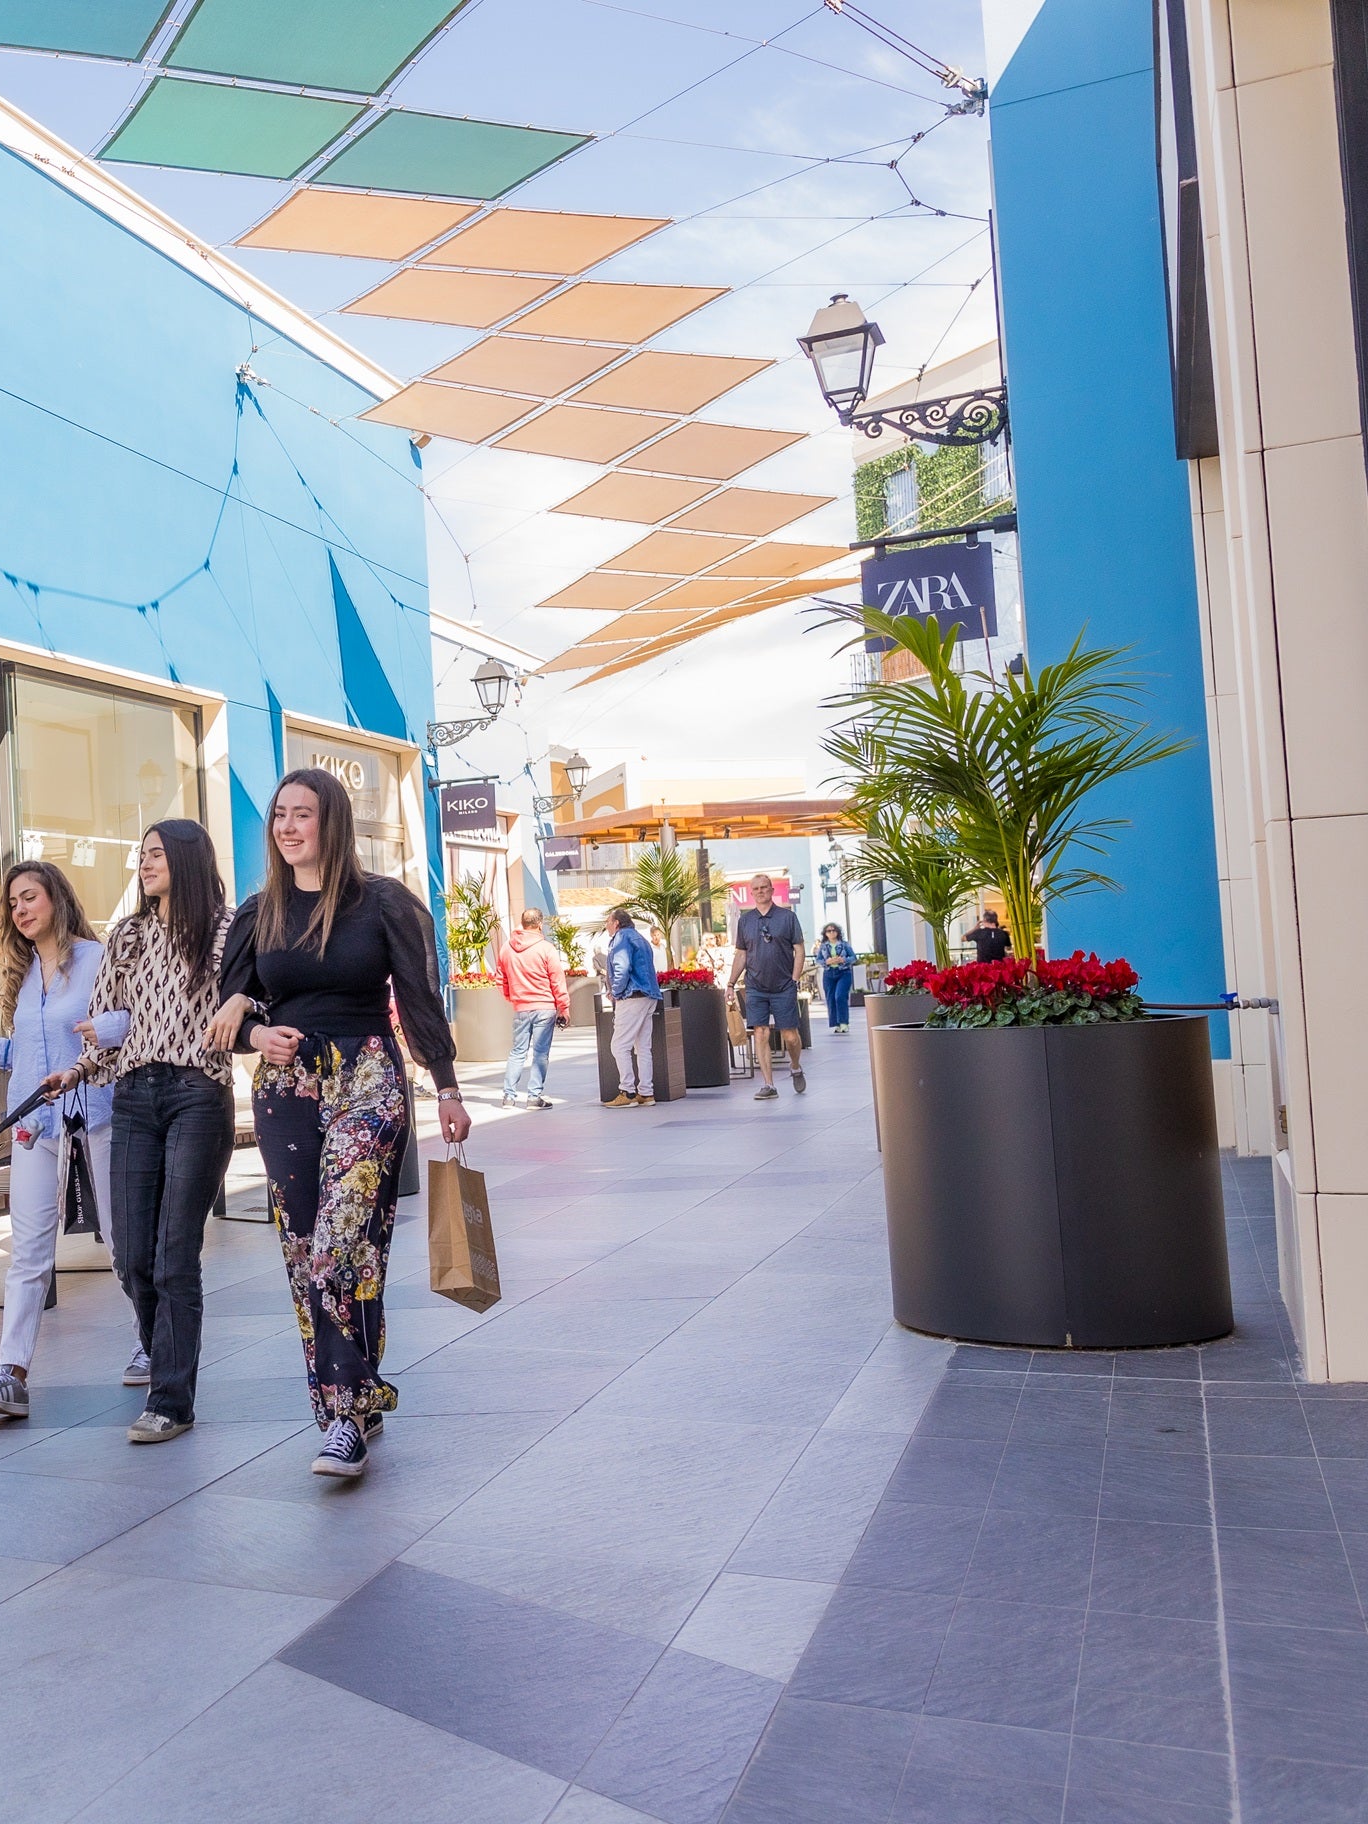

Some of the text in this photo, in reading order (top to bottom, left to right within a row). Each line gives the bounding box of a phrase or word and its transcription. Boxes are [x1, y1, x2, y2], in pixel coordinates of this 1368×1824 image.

[876, 571, 977, 619] ZARA
[446, 797, 489, 812] KIKO
[77, 1204, 85, 1224] SHOP
